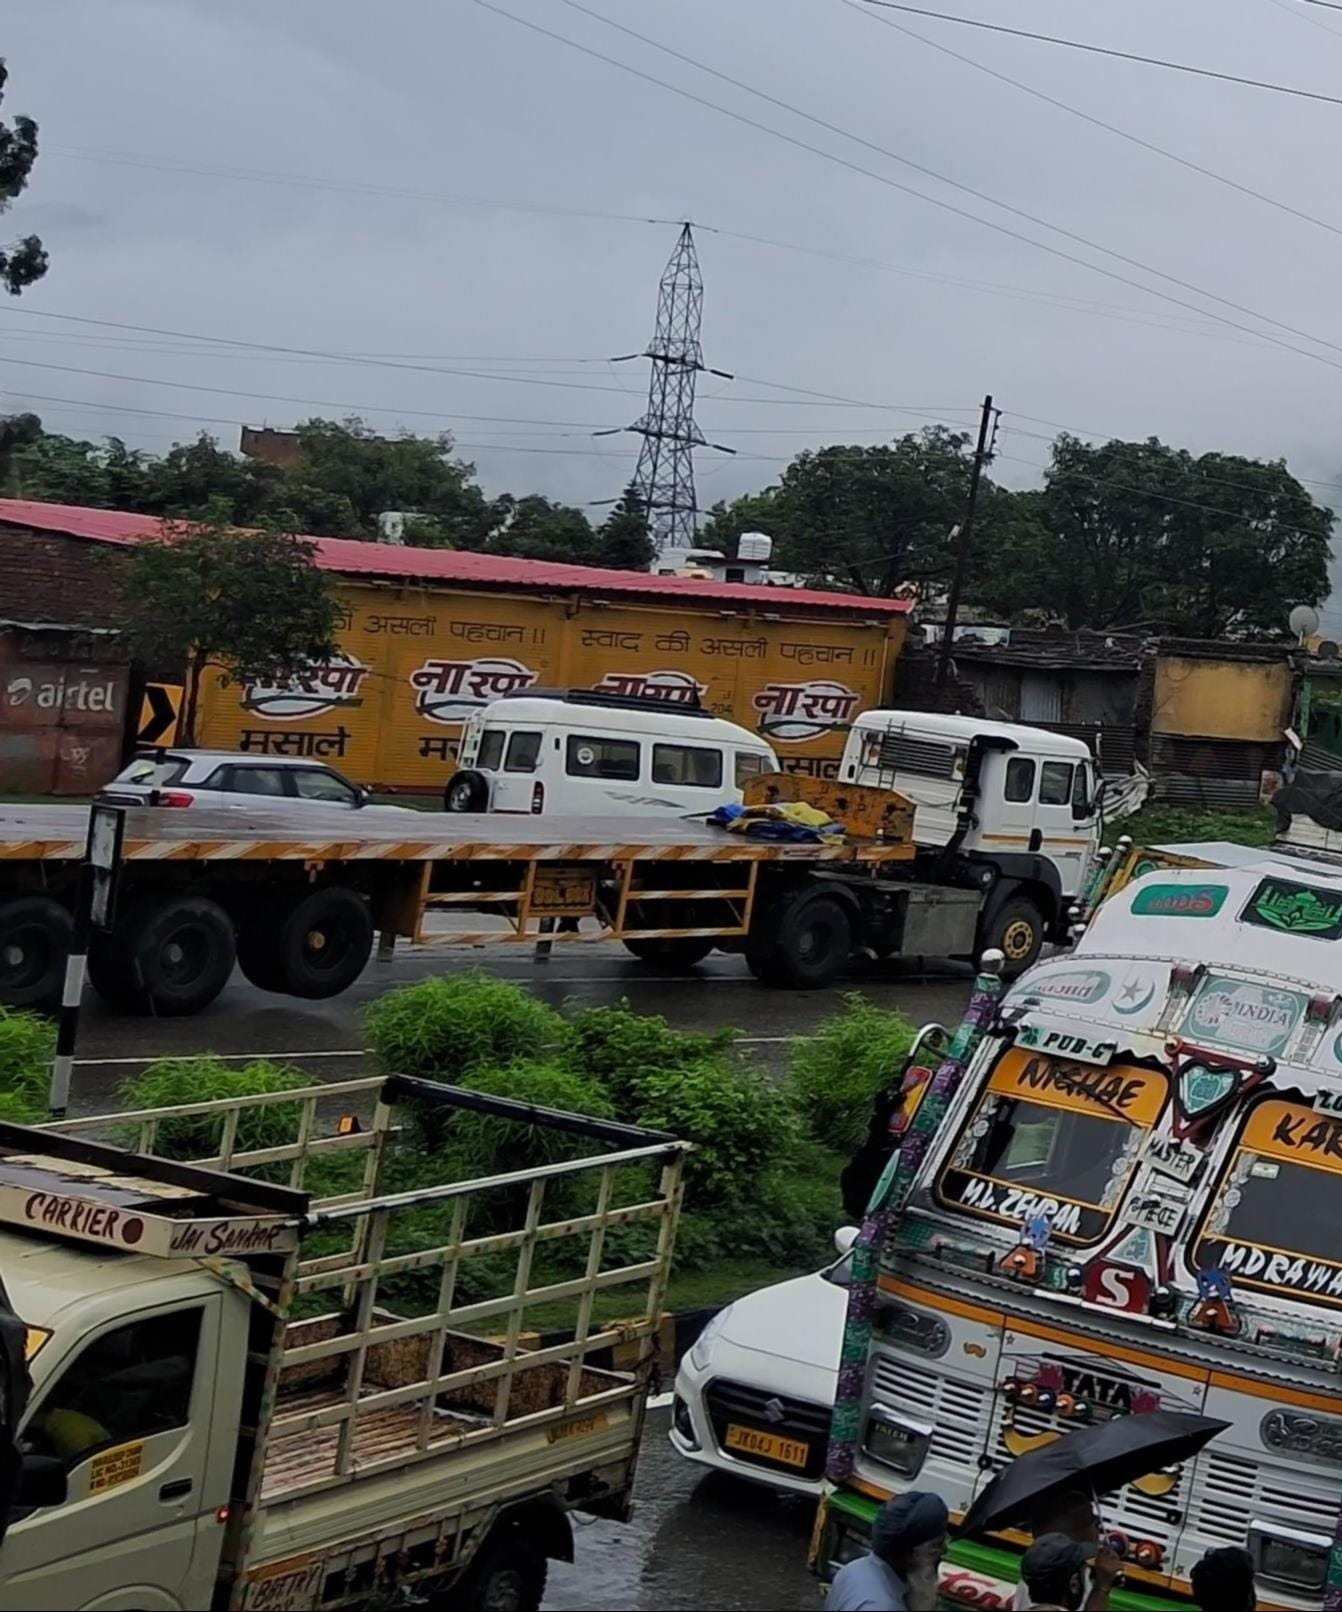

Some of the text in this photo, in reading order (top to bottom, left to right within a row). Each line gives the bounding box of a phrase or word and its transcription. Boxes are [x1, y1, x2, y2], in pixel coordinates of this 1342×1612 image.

[363, 614, 437, 636] असली
[450, 619, 526, 644] पहचान
[581, 628, 644, 653] स्वाद
[655, 630, 691, 654] की
[701, 637, 769, 659] असली
[780, 642, 856, 666] पहचान
[37, 676, 114, 711] airtel
[754, 686, 859, 720] नारपा
[241, 726, 352, 758] मसाले
[1237, 1001, 1288, 1027] INDIA
[1043, 1032, 1111, 1059] PUB-G
[1149, 1136, 1196, 1175] MASTER
[25, 1192, 121, 1240] CARRIER
[1096, 1267, 1136, 1308] S
